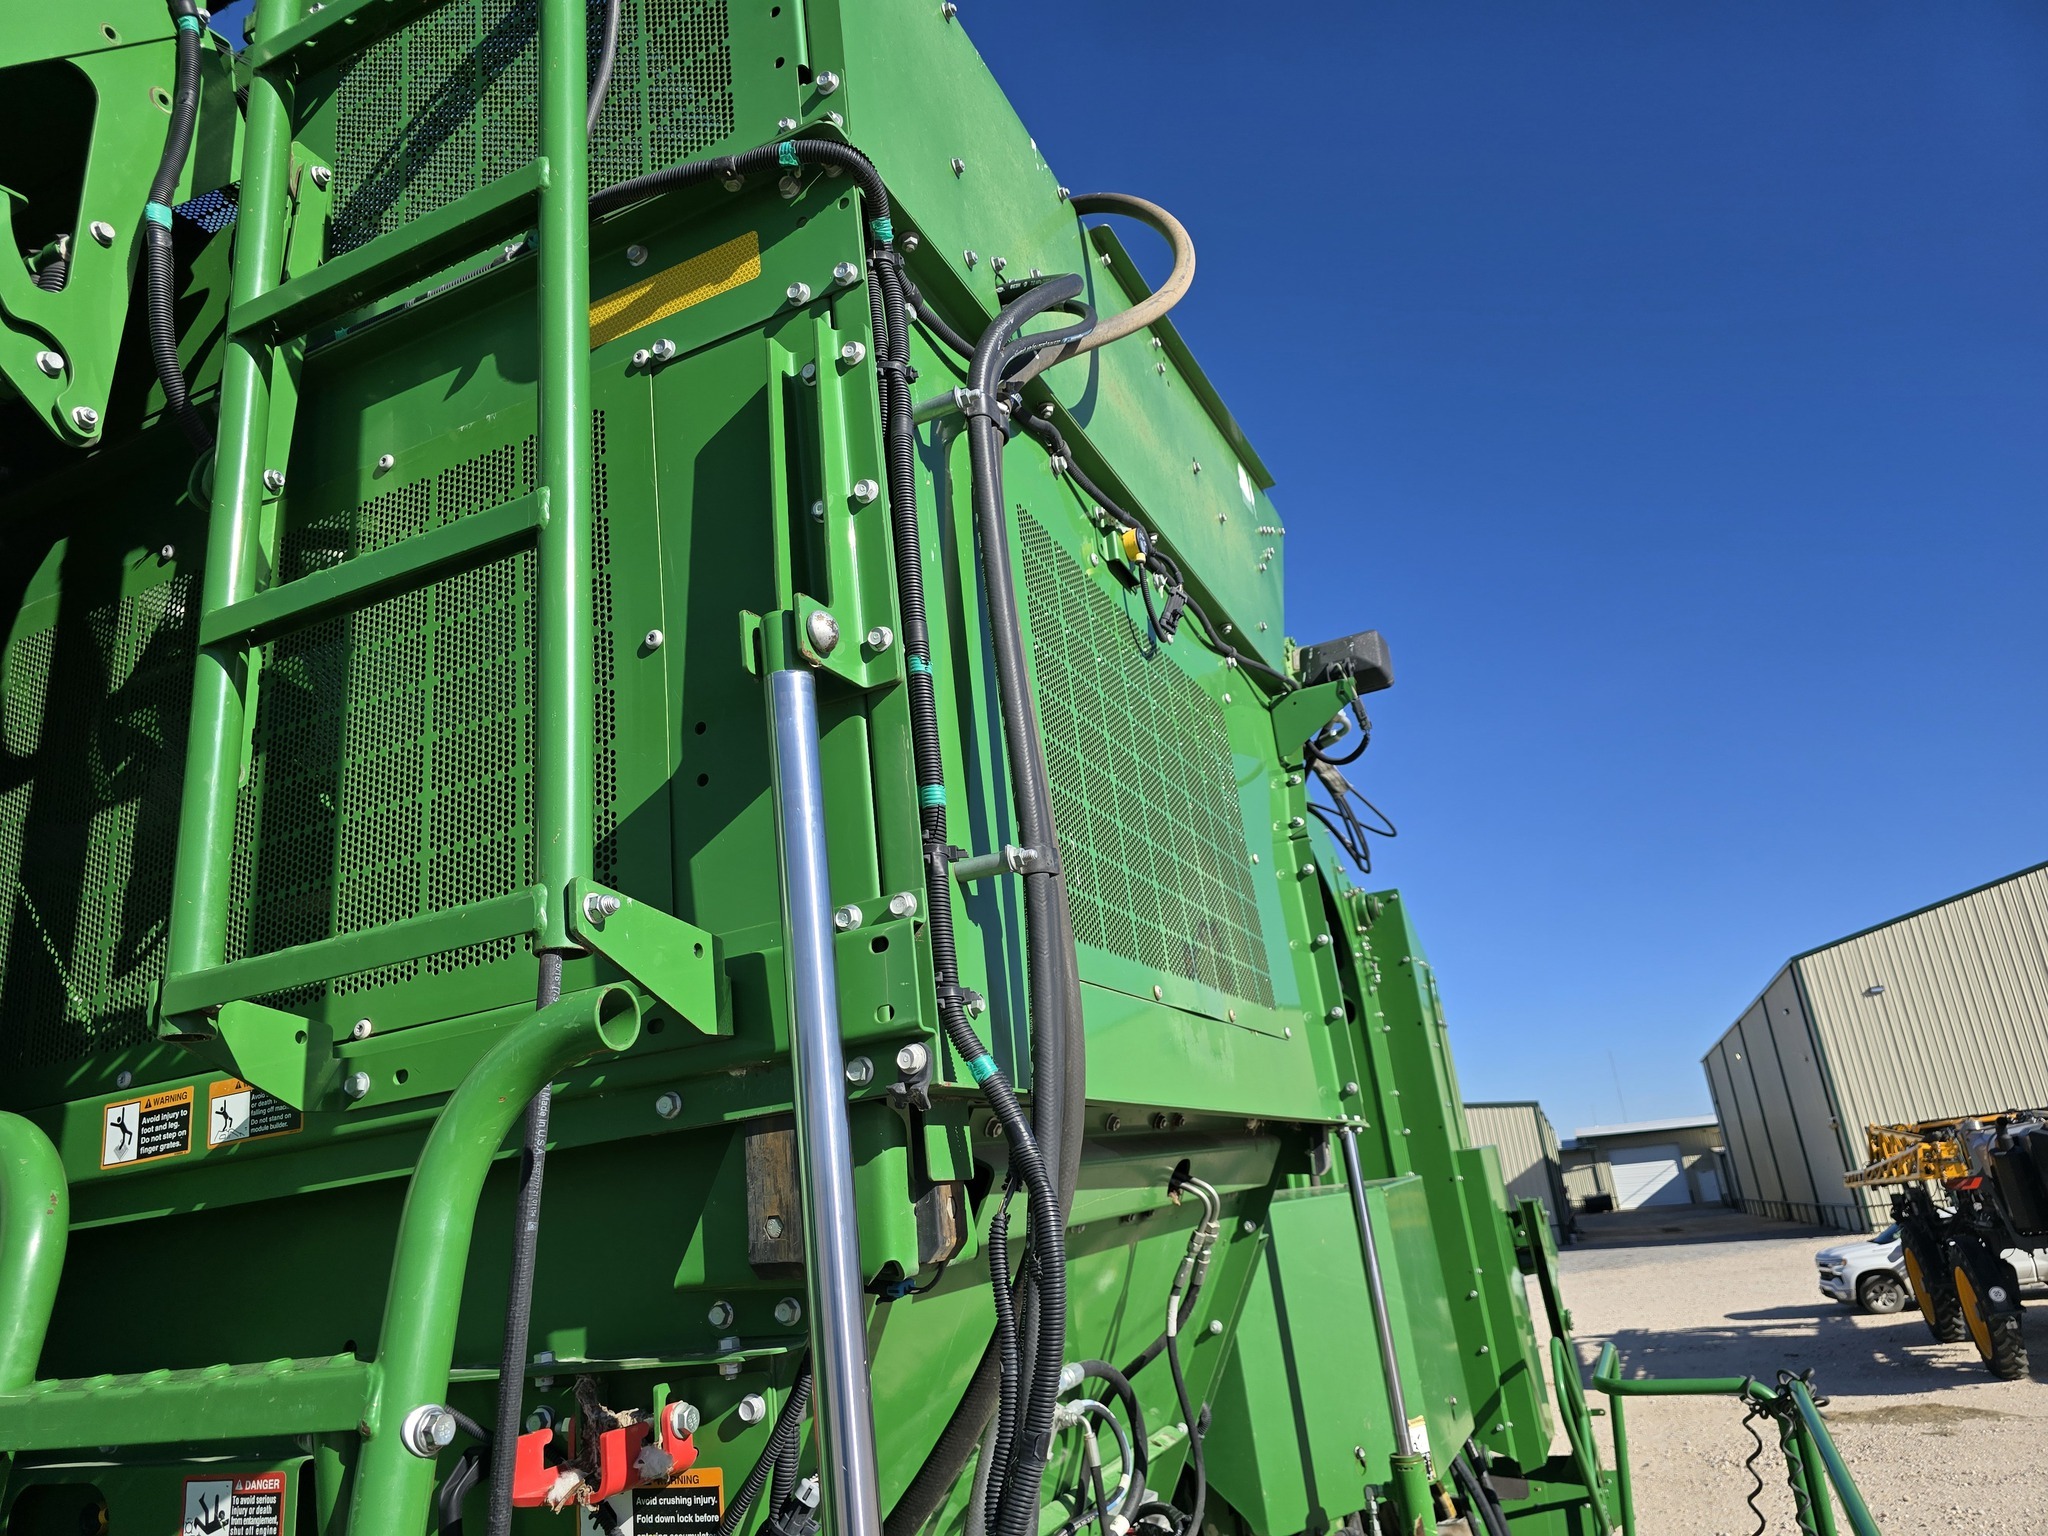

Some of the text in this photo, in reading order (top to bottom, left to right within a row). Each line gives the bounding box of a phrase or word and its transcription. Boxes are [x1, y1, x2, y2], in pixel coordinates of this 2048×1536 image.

[153, 1092, 187, 1106] WARNING
[258, 1099, 272, 1107] death
[540, 1092, 550, 1116] Made
[251, 1108, 266, 1116] falling
[267, 1105, 275, 1113] off
[141, 1109, 188, 1125] Avoid injury to
[250, 1118, 258, 1126] Do
[259, 1116, 268, 1124] not
[269, 1114, 283, 1122] stand
[141, 1121, 180, 1135] foot and leg.
[250, 1125, 269, 1134] module
[140, 1129, 187, 1145] Do not step on
[139, 1141, 182, 1155] finger grates.
[245, 1479, 280, 1490] DANGER
[232, 1494, 277, 1505] To avoid serious
[636, 1495, 718, 1507] Avoid crushing injury.
[231, 1505, 272, 1517] injury or death
[231, 1516, 243, 1525] from
[636, 1512, 720, 1524] Fold down lock before
[230, 1525, 277, 1536] shut off engine
